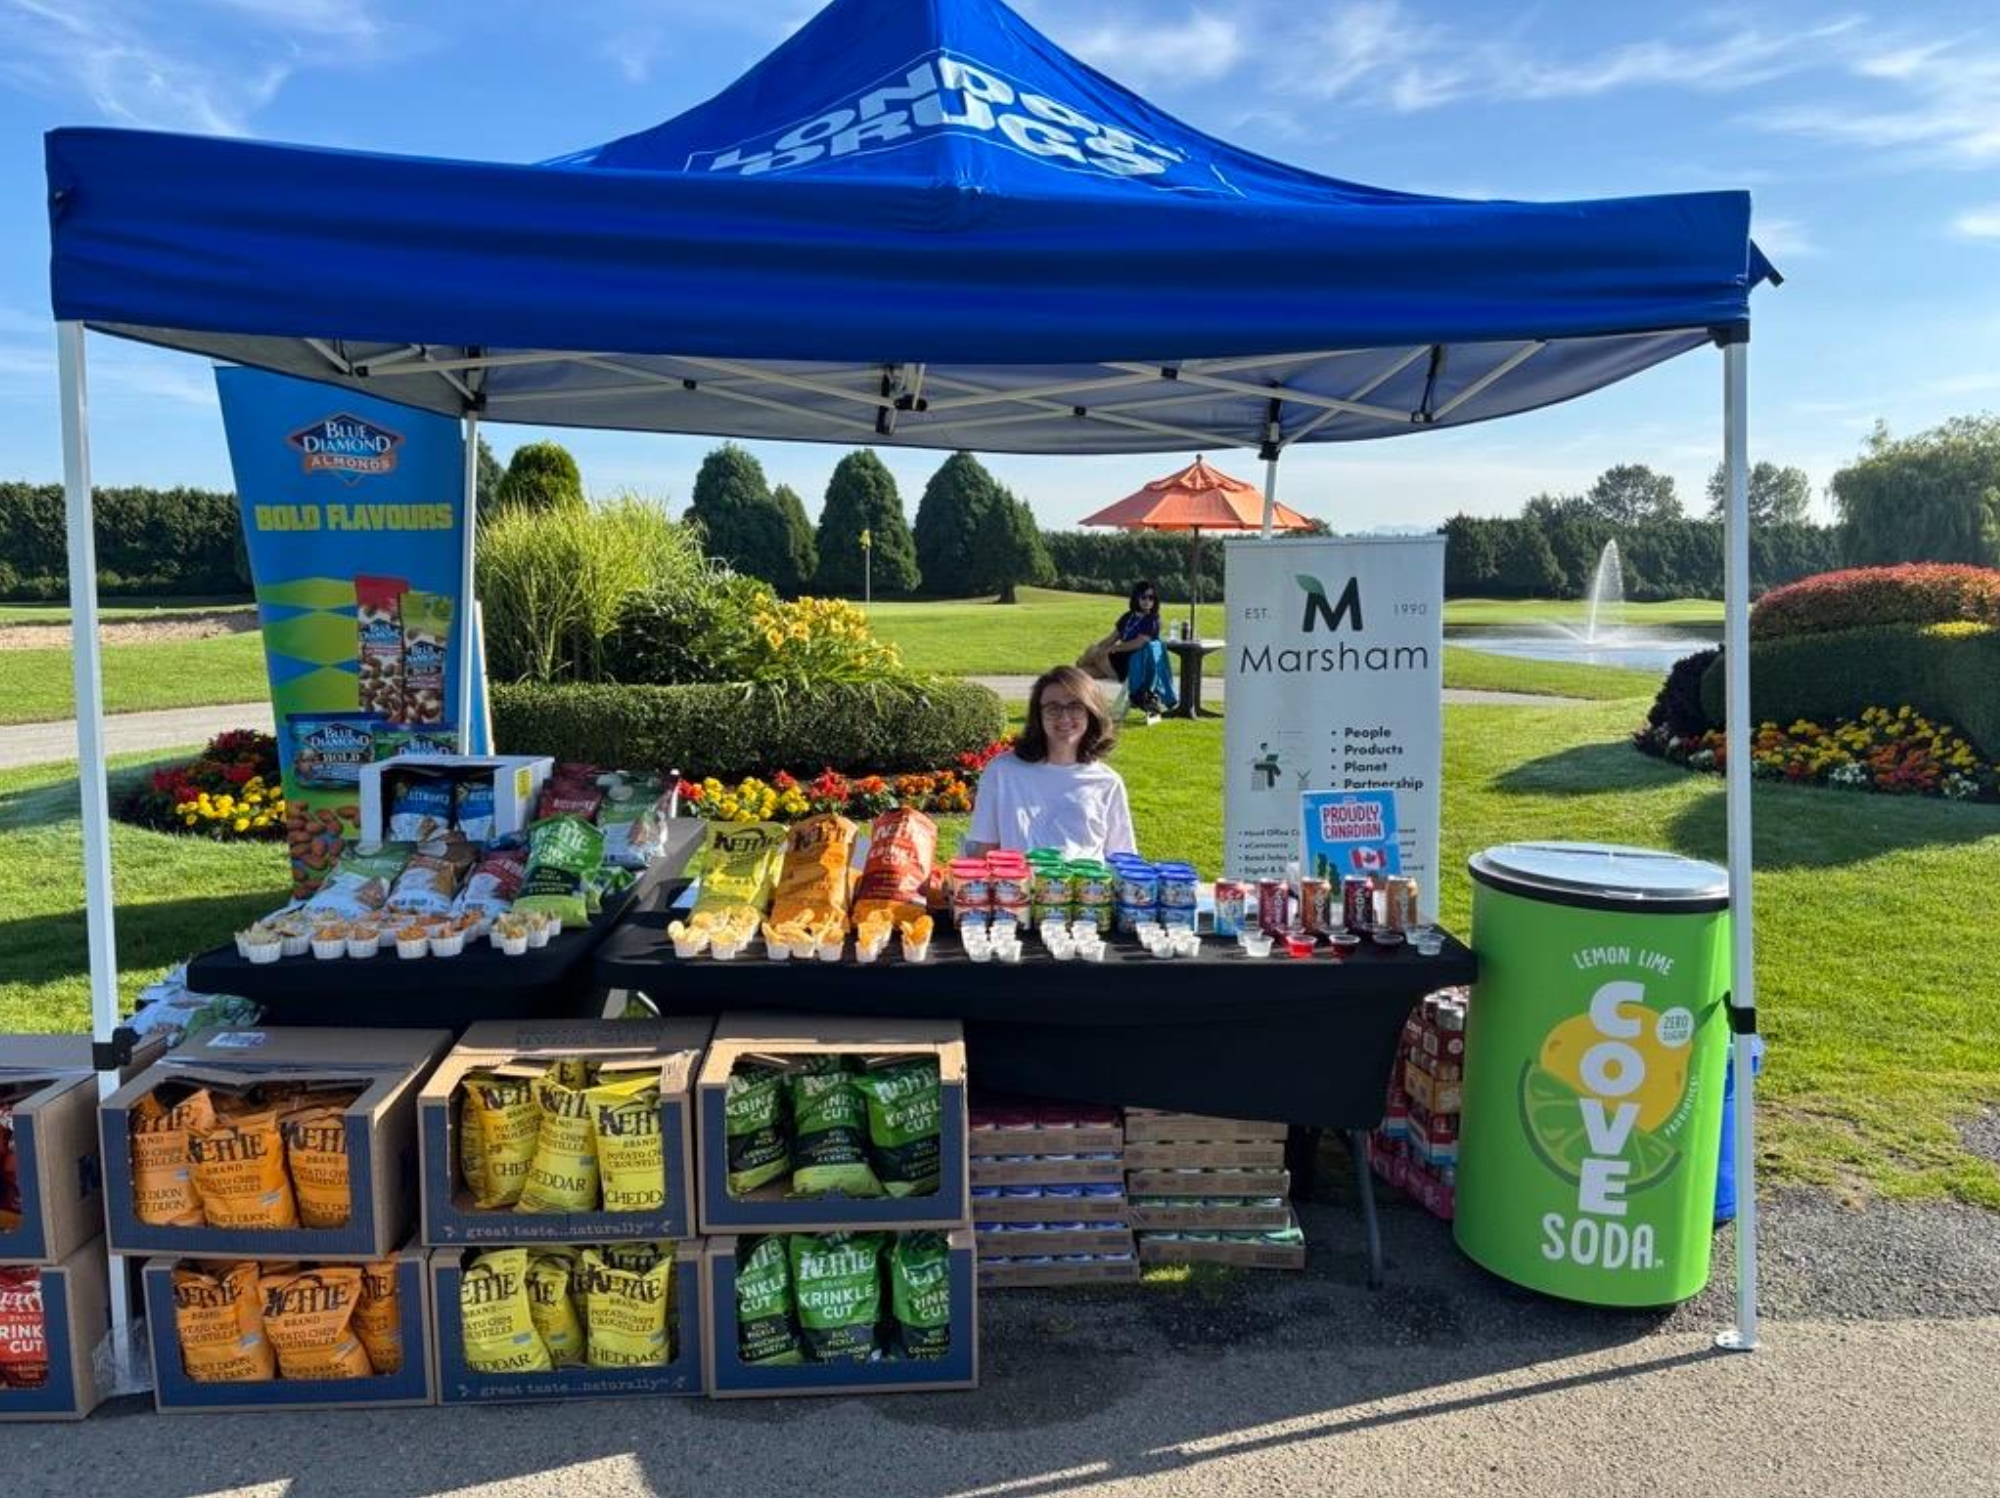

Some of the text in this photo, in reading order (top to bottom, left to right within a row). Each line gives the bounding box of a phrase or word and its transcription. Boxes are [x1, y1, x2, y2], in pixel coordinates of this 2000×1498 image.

[325, 420, 367, 438] BLUE
[303, 435, 391, 453] DIAMOND
[311, 456, 391, 470] ALMONDS
[255, 504, 453, 531] BOLD FLAVOURS
[1394, 604, 1427, 615] 1990
[1240, 642, 1429, 673] Marsham
[324, 727, 352, 738] BLUE
[1344, 726, 1392, 740] People
[310, 736, 370, 747] DIAMOND
[1344, 744, 1404, 756] Products
[1344, 761, 1388, 773] Planet
[1344, 778, 1424, 791] Partnership
[1323, 805, 1380, 824] PROUDLY
[1324, 823, 1382, 840] CANADIAN
[1572, 946, 1675, 976] LEMON LIME
[1663, 1014, 1688, 1029] ZERO
[1578, 981, 1646, 1215] COVE
[822, 1107, 850, 1121] CUT
[904, 1114, 932, 1133] CUT
[466, 1227, 508, 1239] great
[799, 1246, 875, 1281] KETTLE
[263, 1276, 349, 1317] KETTLE
[799, 1284, 875, 1307] KRINKLE
[740, 1296, 771, 1313] CUT
[823, 1303, 855, 1319] CUT
[10, 1340, 42, 1354] CUT
[481, 1384, 521, 1397] great
